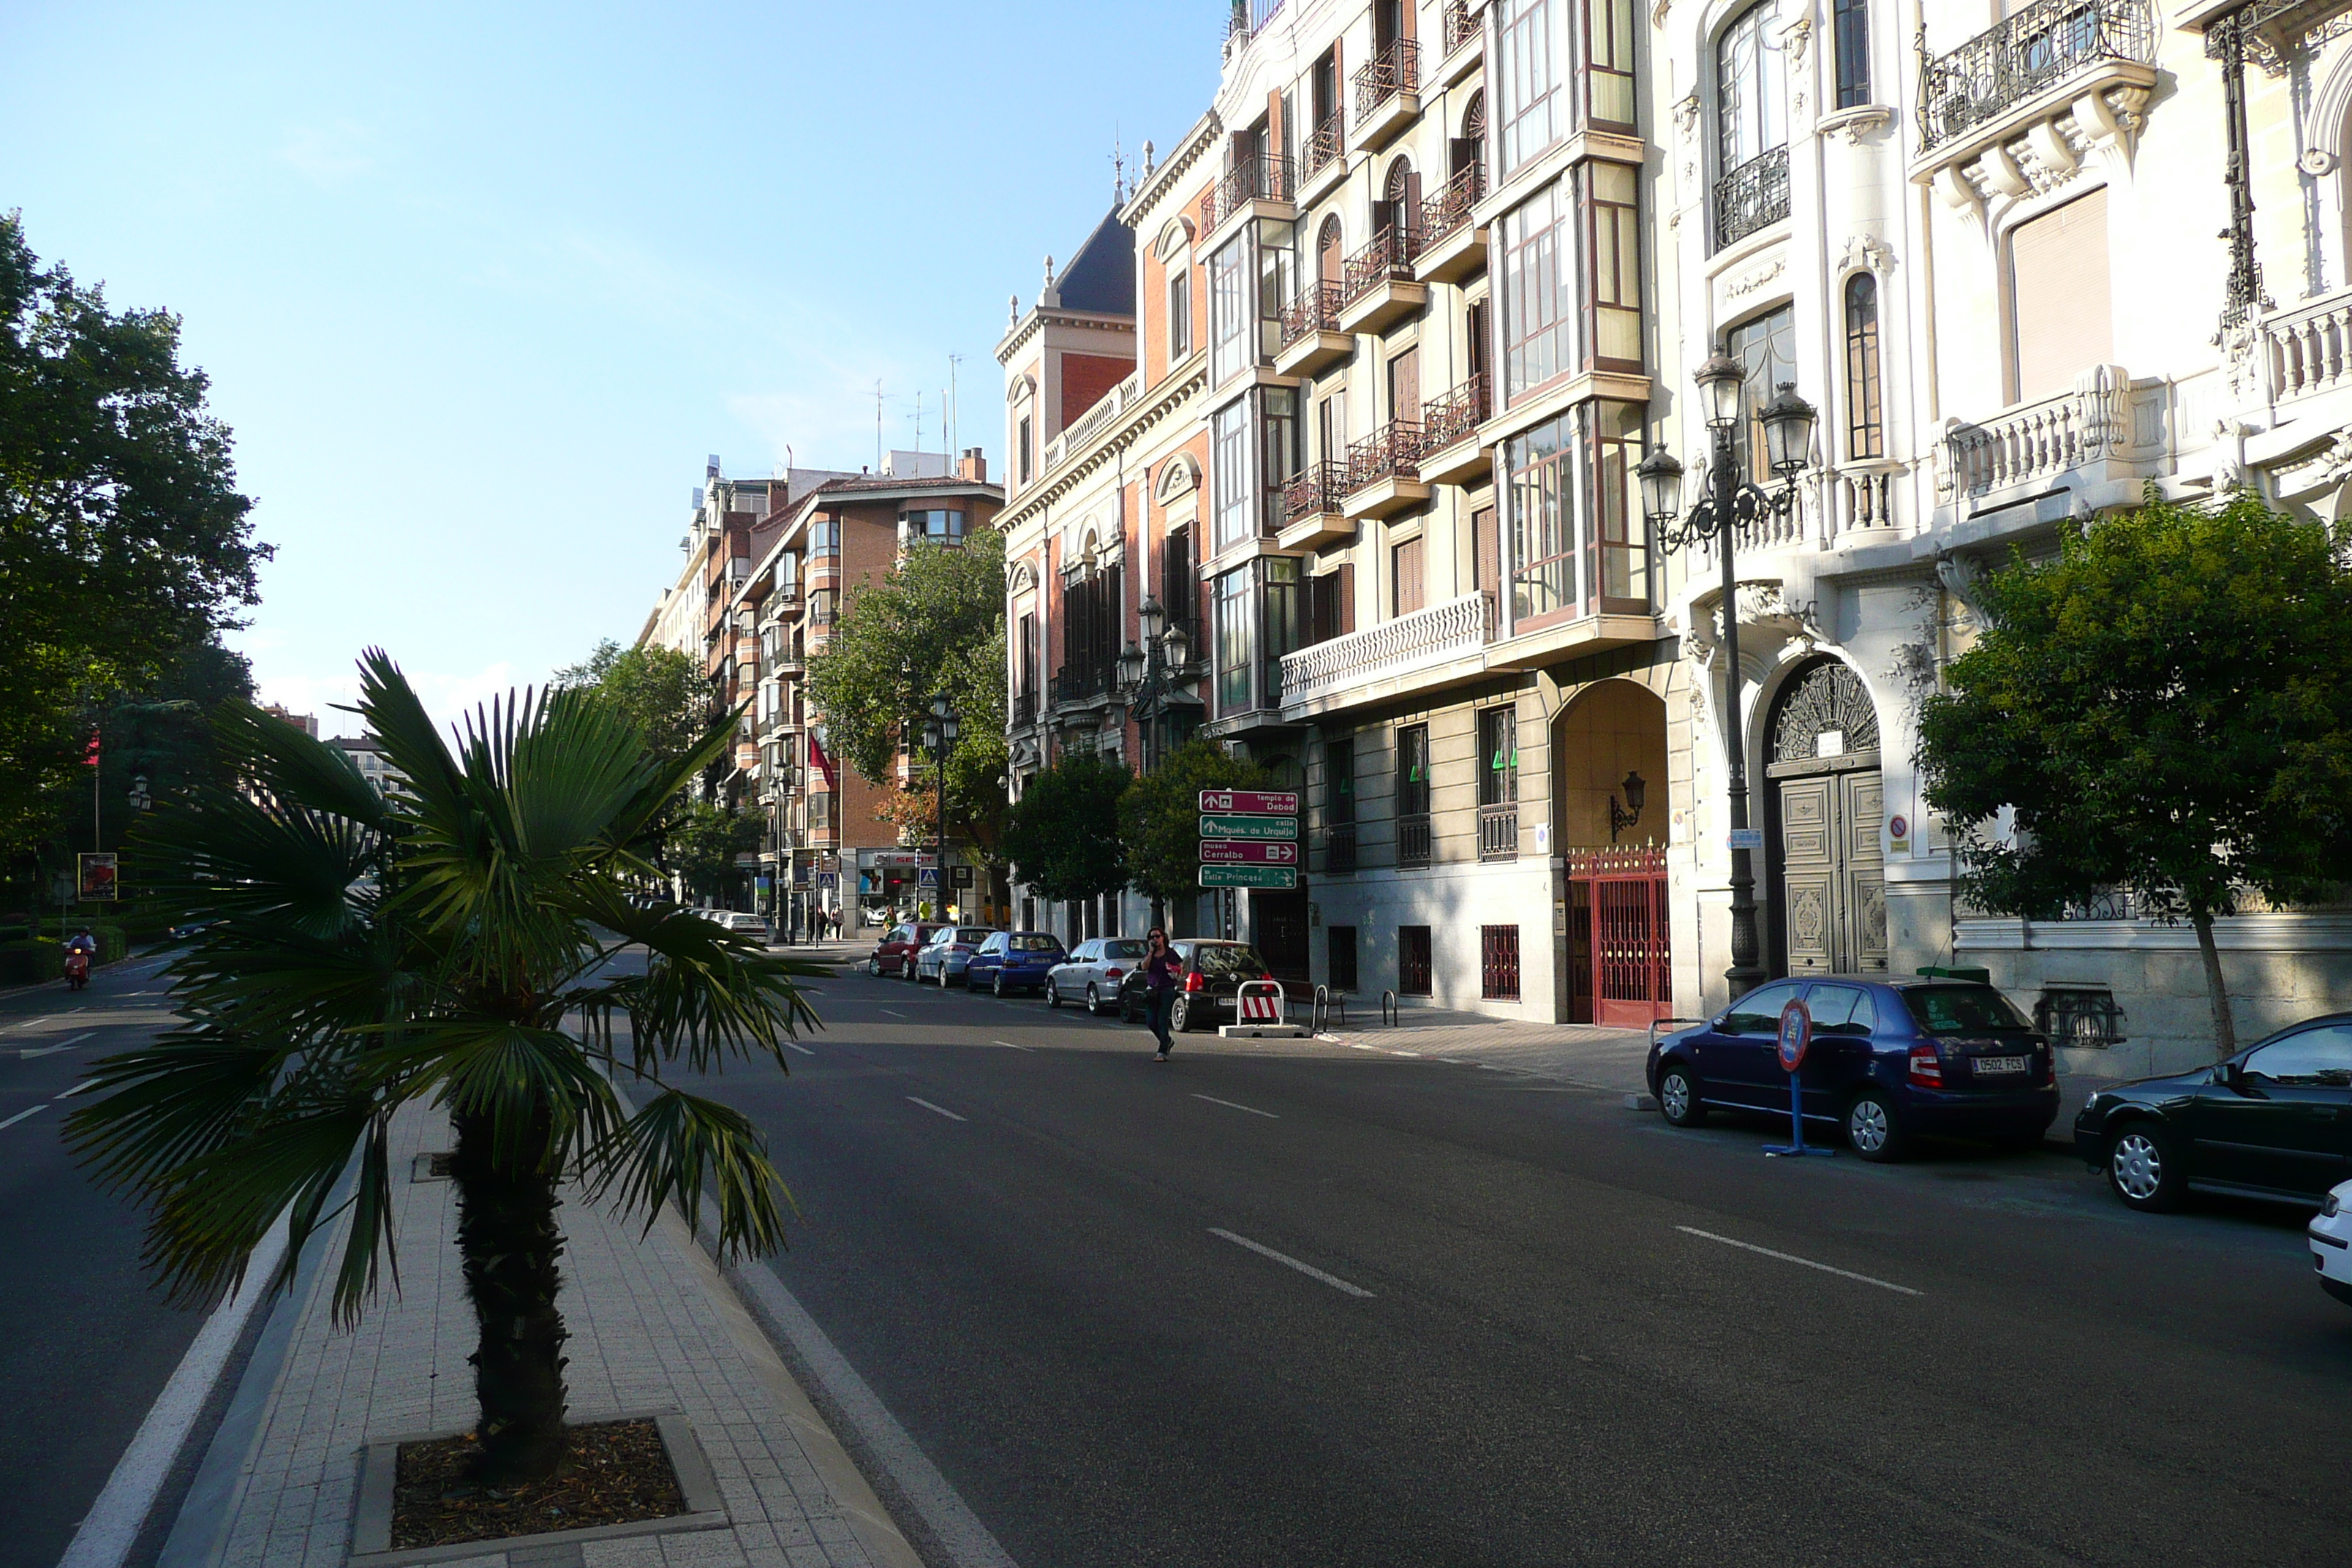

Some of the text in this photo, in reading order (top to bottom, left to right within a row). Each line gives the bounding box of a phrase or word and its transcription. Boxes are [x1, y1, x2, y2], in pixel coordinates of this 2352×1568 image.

[1218, 826, 1246, 835] Mqués.
[1264, 827, 1294, 837] Urquijo
[1204, 850, 1243, 859] Cerralbo
[1226, 873, 1262, 881] Princesa
[1980, 1058, 2022, 1071] 0502 FCS
